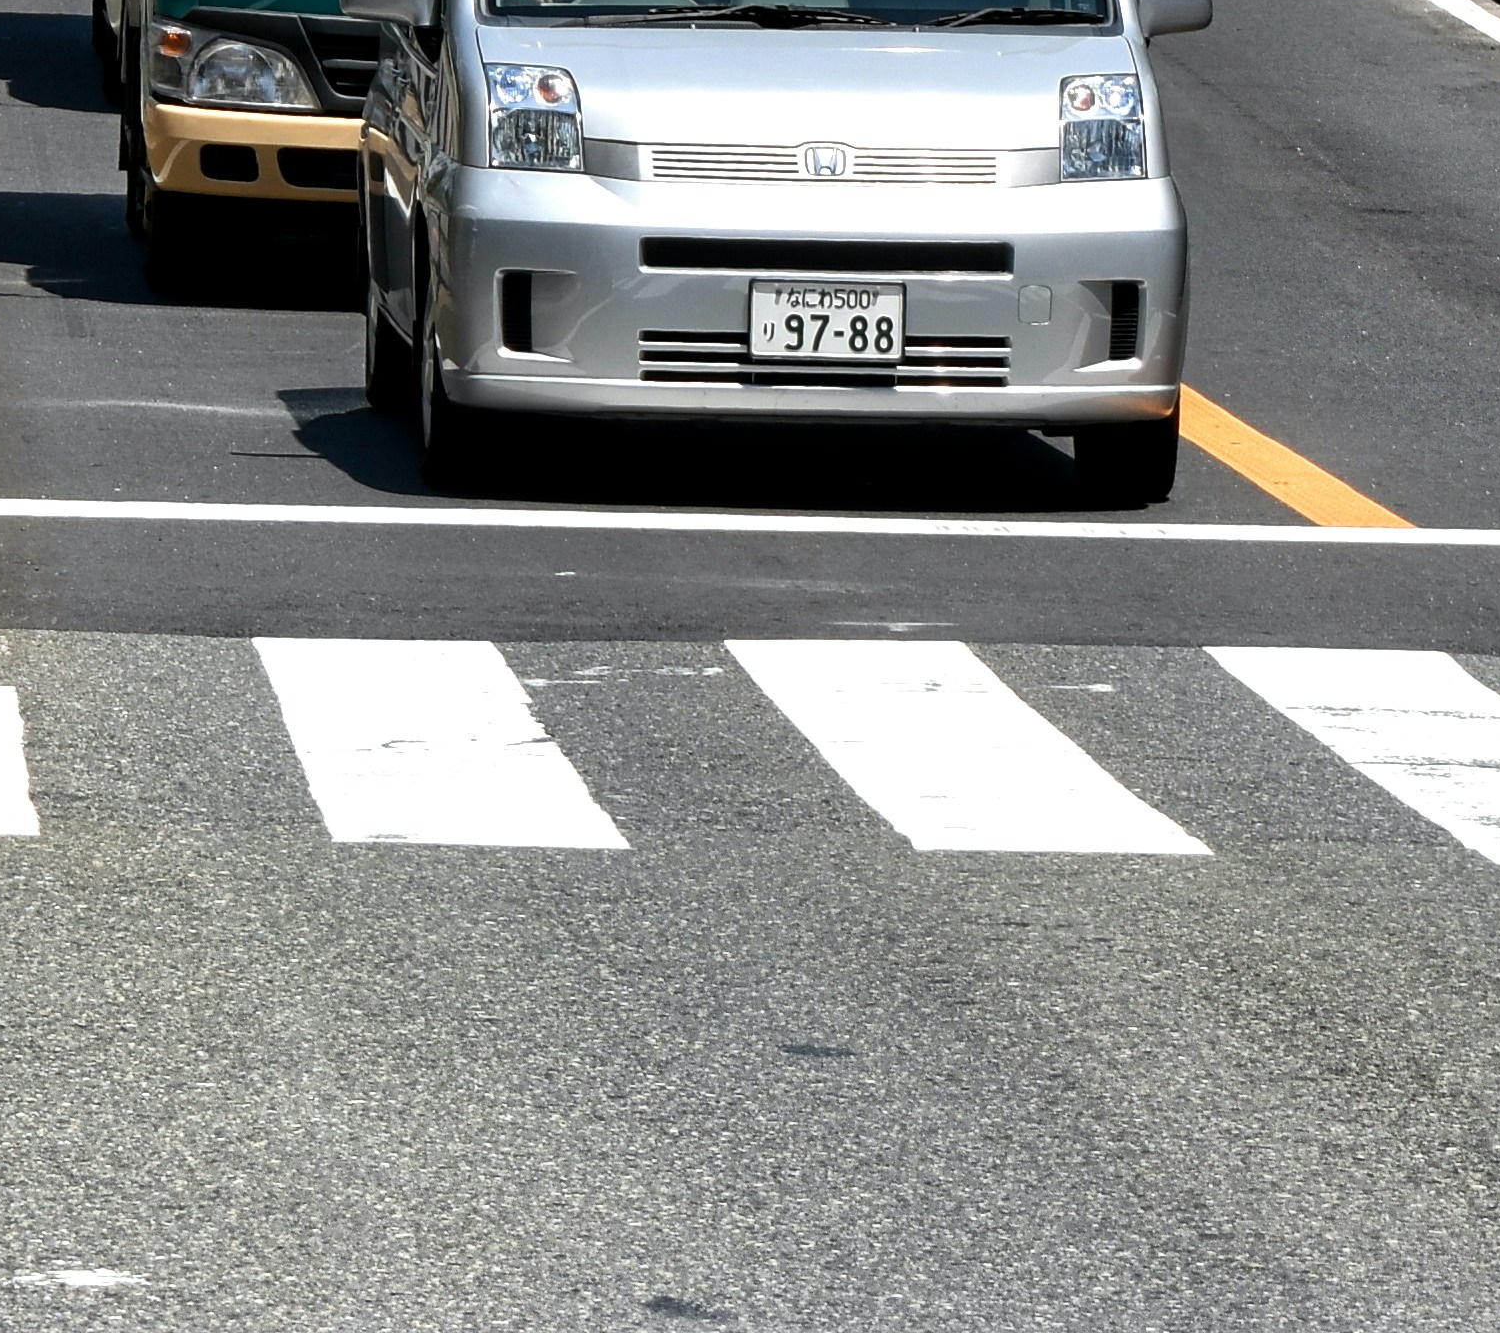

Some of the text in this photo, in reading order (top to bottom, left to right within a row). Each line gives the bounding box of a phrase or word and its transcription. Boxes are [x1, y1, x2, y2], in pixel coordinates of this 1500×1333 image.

[786, 287, 871, 310] なにわ500
[784, 313, 894, 354] 97-88
